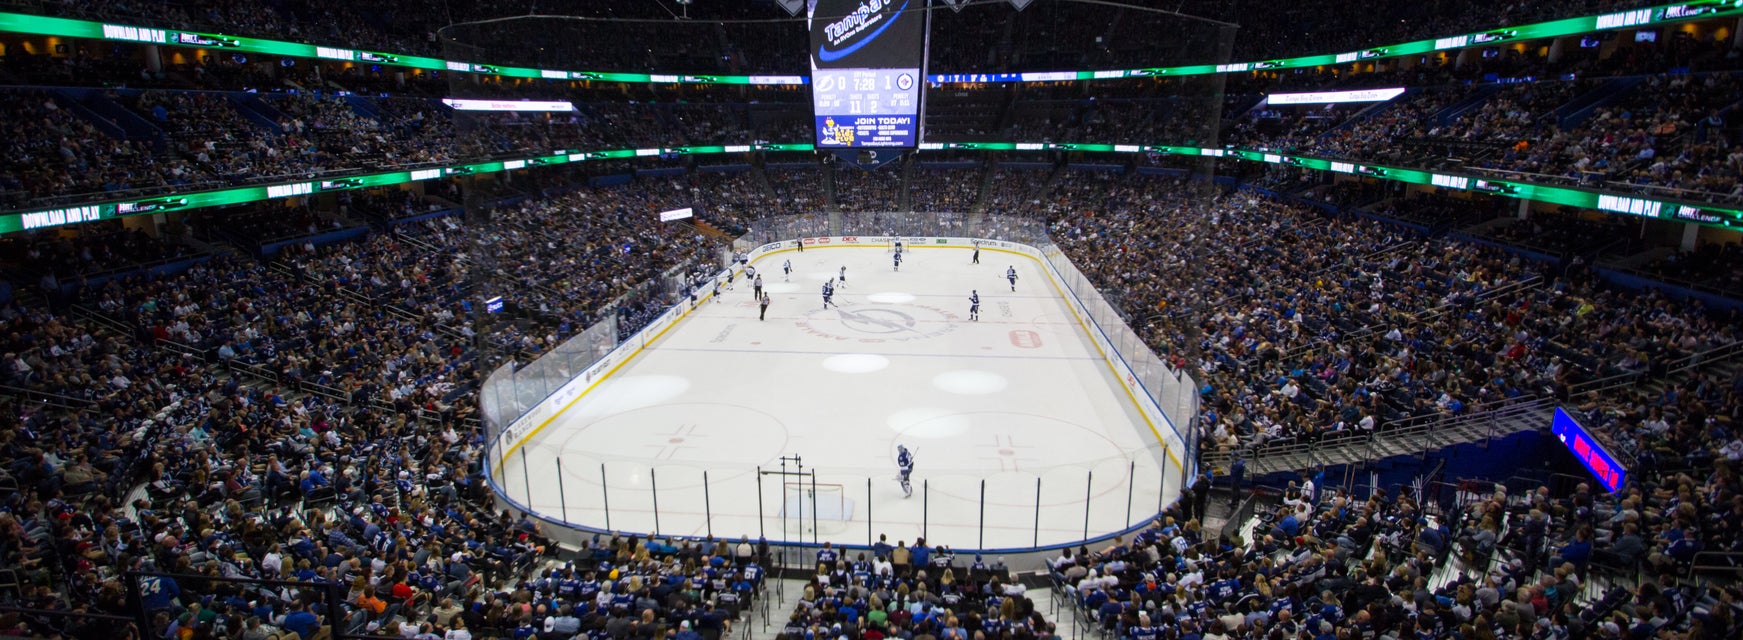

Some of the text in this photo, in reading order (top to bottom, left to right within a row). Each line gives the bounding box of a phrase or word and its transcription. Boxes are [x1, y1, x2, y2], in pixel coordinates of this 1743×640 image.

[1596, 12, 1624, 30] DOWNLOAD
[1624, 10, 1636, 26] AND
[1636, 8, 1652, 24] PLAY
[102, 24, 138, 41] DOWNLOAD
[138, 28, 152, 42] AND
[151, 29, 166, 43] PLAY
[838, 76, 891, 91] 0 7:28 1
[850, 100, 861, 113] 11
[870, 100, 878, 113] 2
[1597, 194, 1630, 213] DOWNLOAD
[1630, 198, 1644, 215] AND
[1643, 200, 1662, 217] PLAY
[22, 208, 66, 230] DOWNLOAD
[66, 207, 82, 224] AND
[82, 205, 100, 222] PLAY
[762, 242, 781, 252] GEICO
[140, 579, 161, 597] 24
